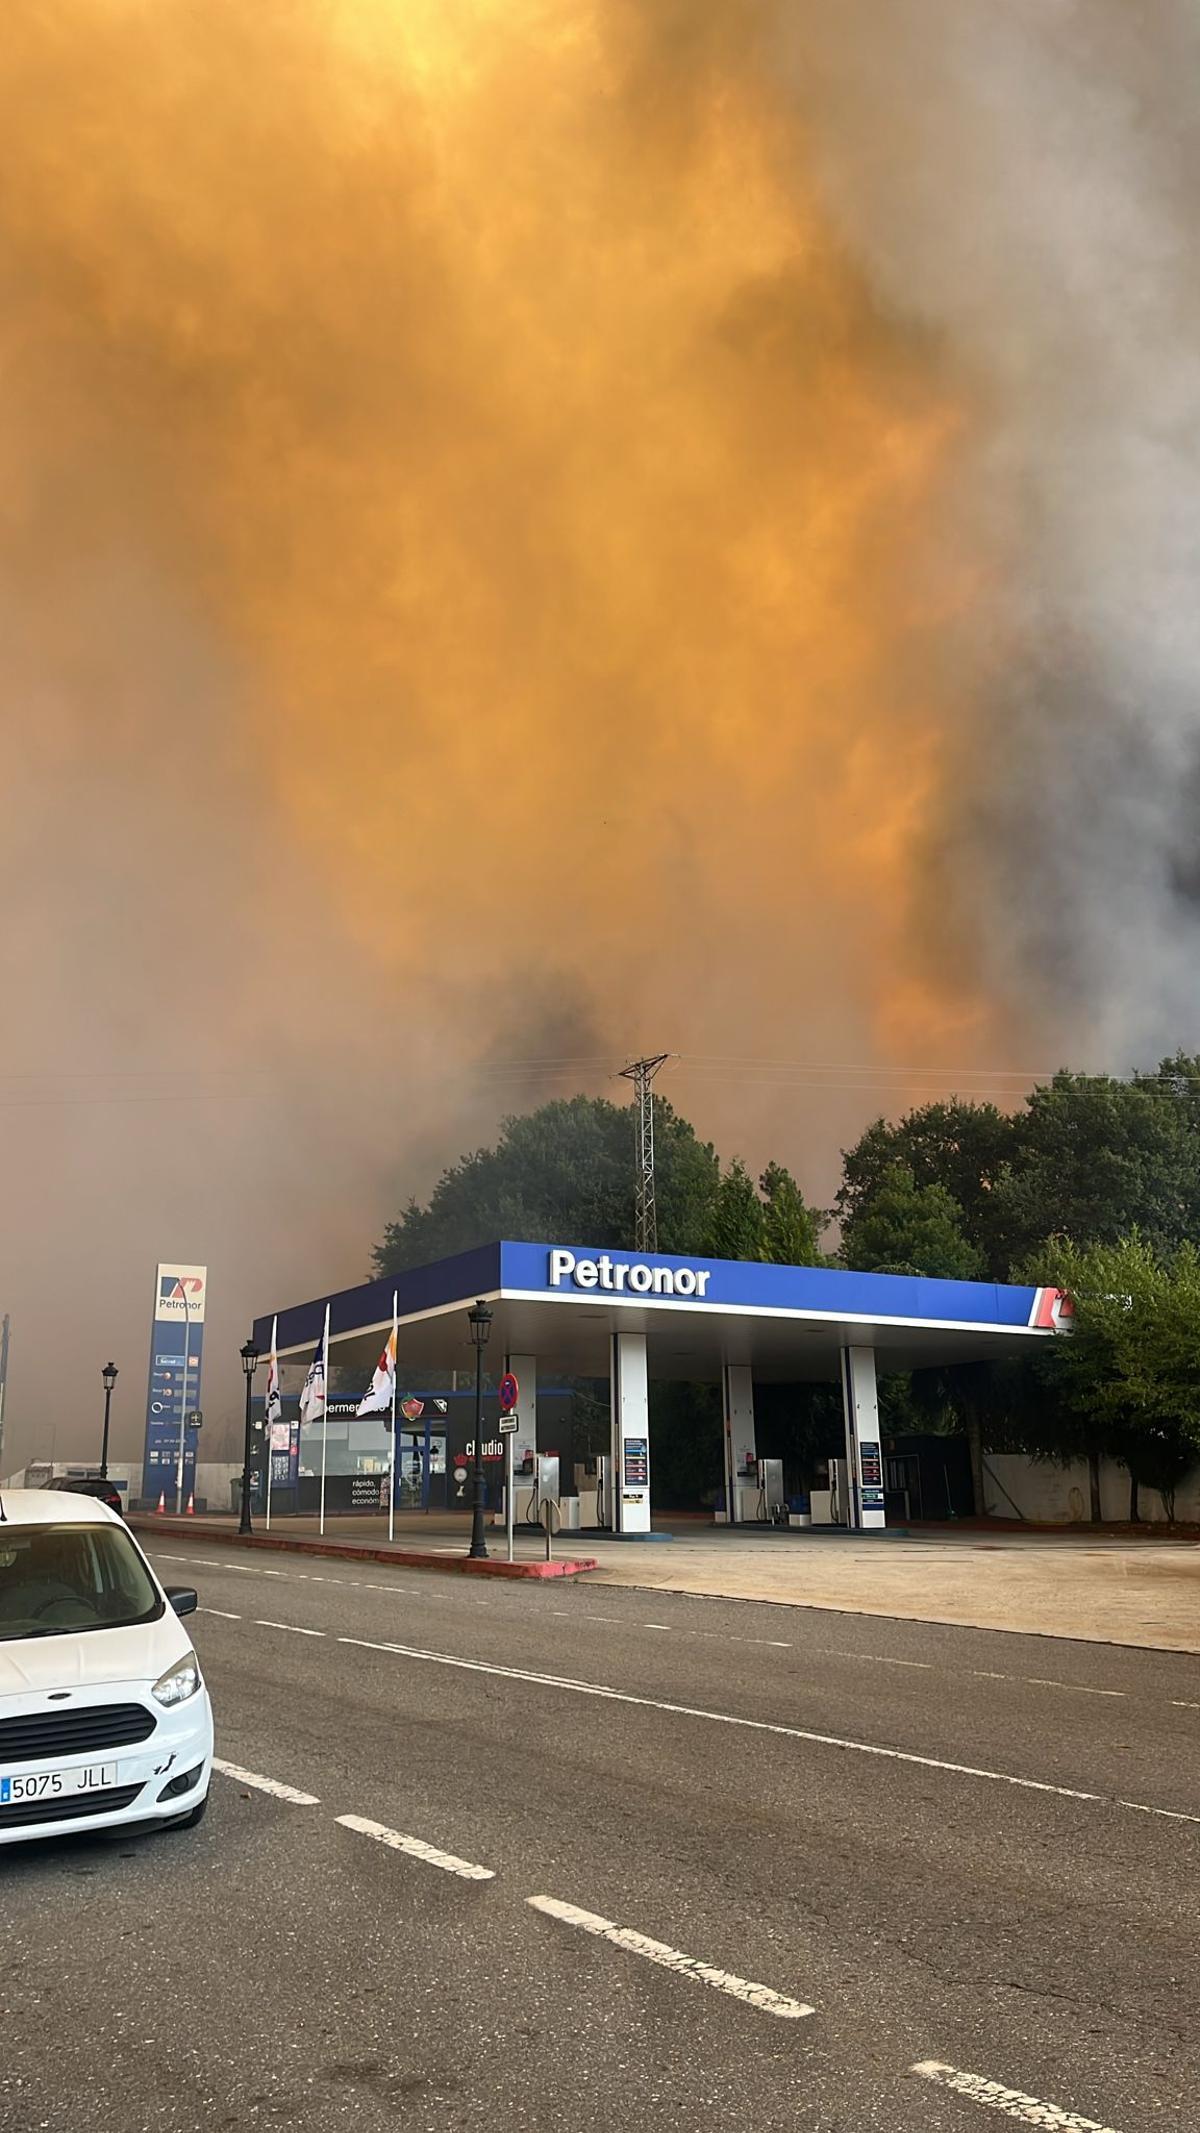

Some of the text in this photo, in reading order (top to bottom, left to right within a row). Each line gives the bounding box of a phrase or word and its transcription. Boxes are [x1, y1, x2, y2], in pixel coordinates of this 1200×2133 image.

[549, 1249, 711, 1297] Petronor
[159, 1299, 202, 1311] Petronor
[465, 1439, 504, 1457] cludio
[12, 1767, 112, 1799] 5075 JLL
